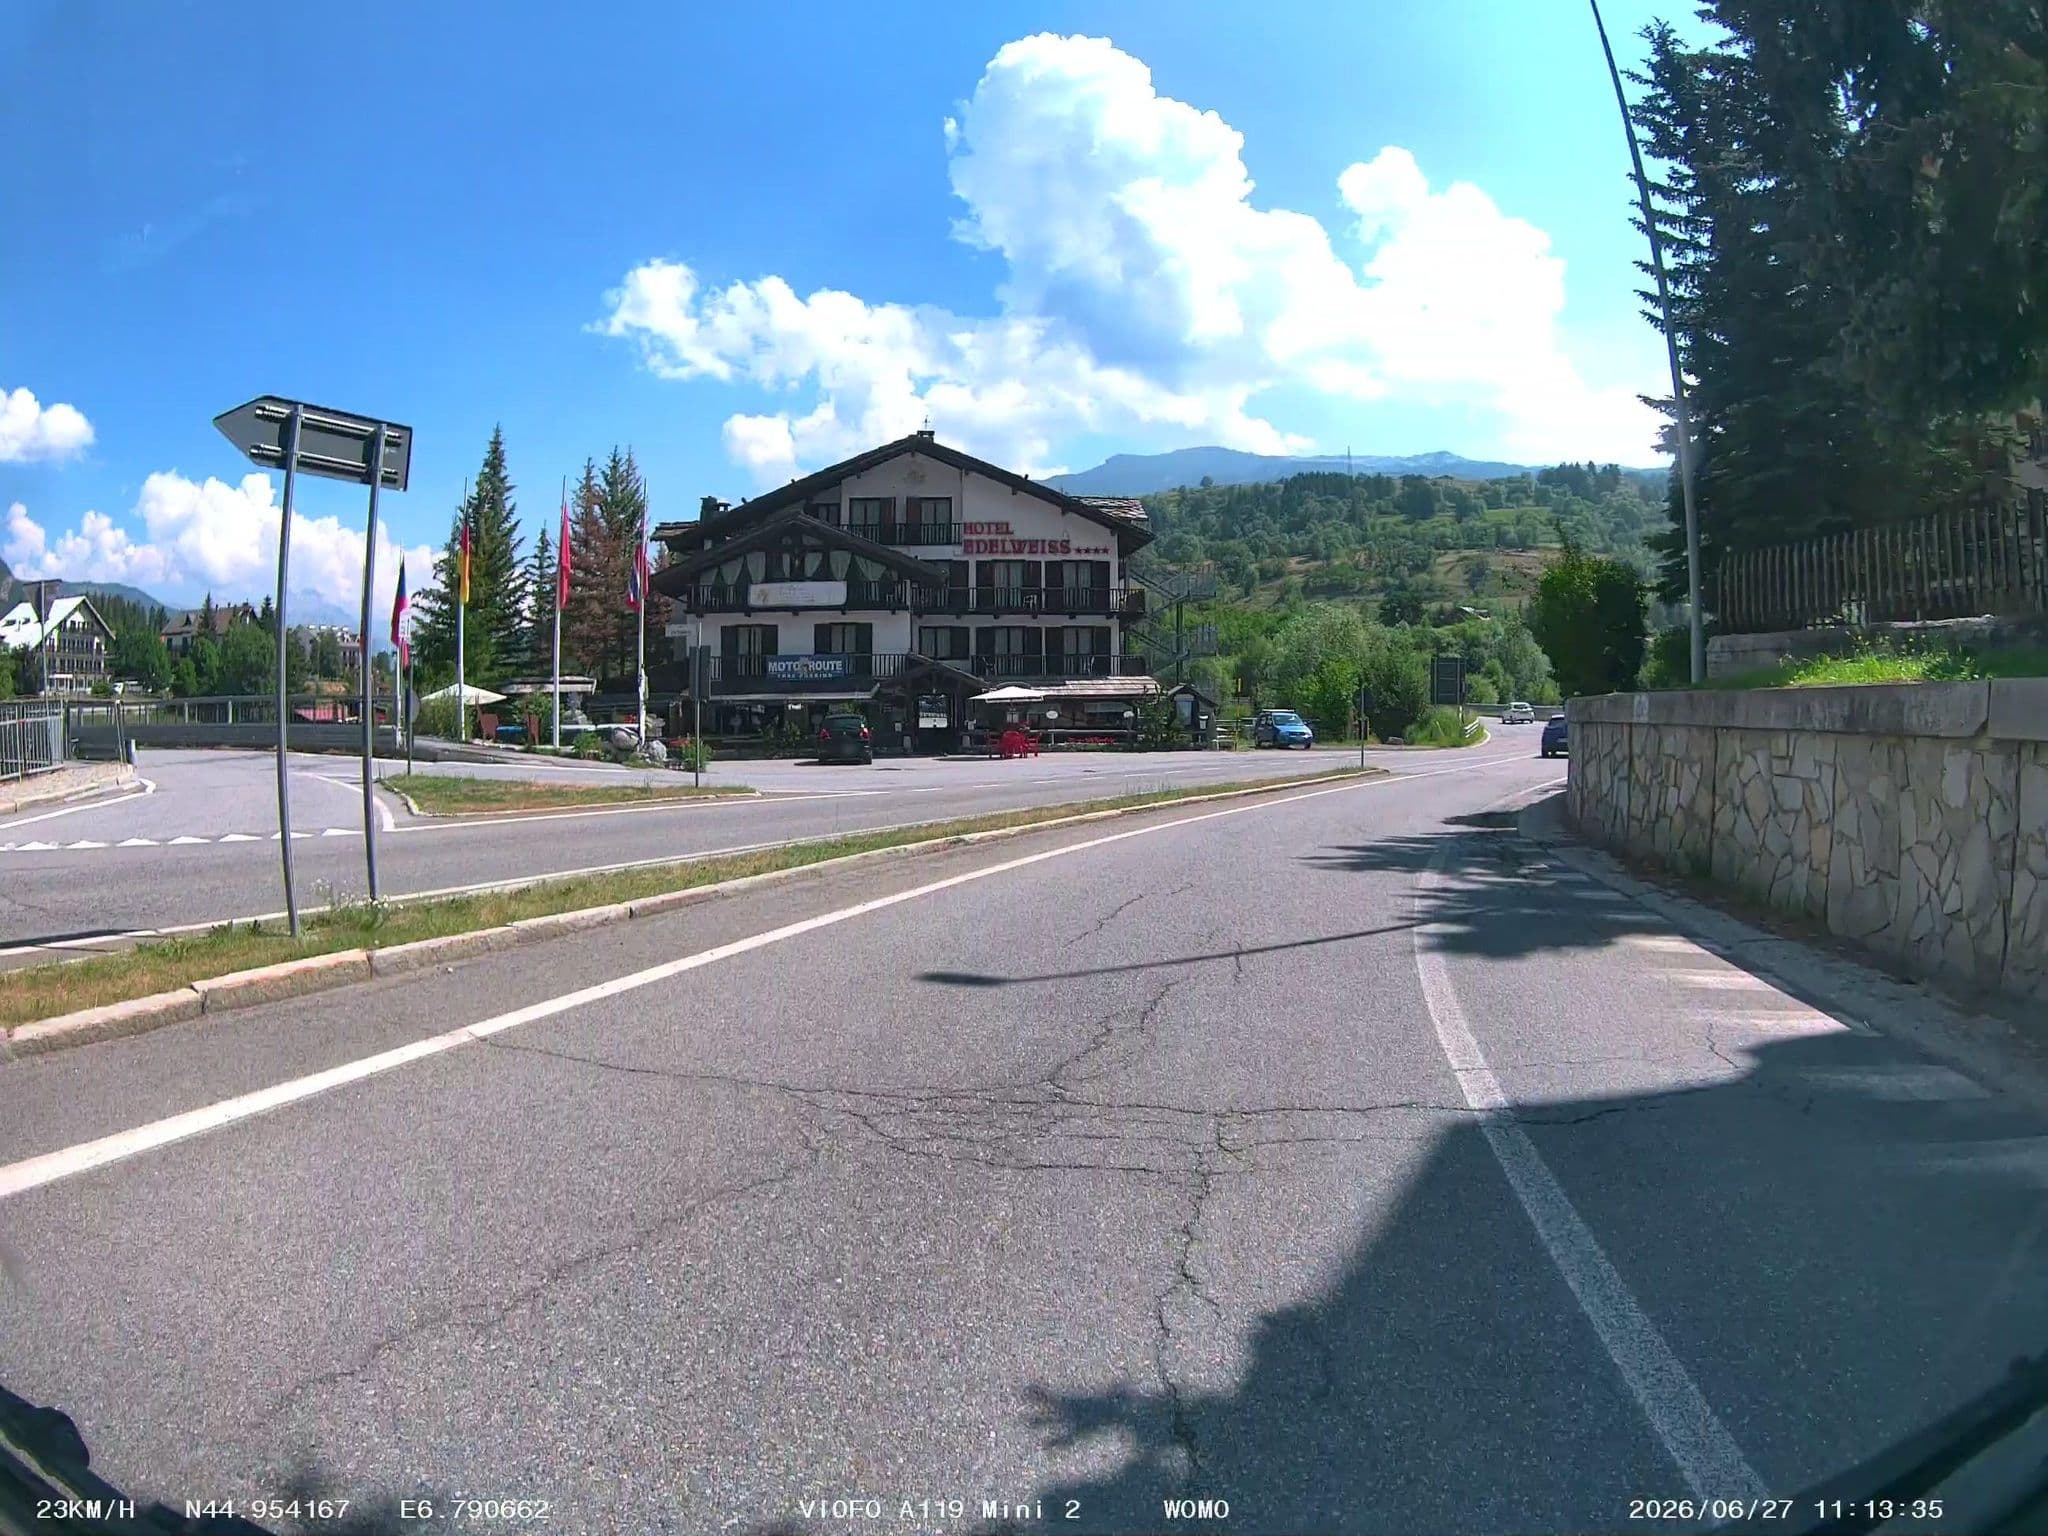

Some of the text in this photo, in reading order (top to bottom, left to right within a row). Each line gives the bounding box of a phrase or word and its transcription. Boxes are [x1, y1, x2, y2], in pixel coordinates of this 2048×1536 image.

[963, 522, 1014, 535] HOTEL
[963, 539, 1071, 554] EDELWEISS
[768, 661, 842, 673] MOTO ROUTE
